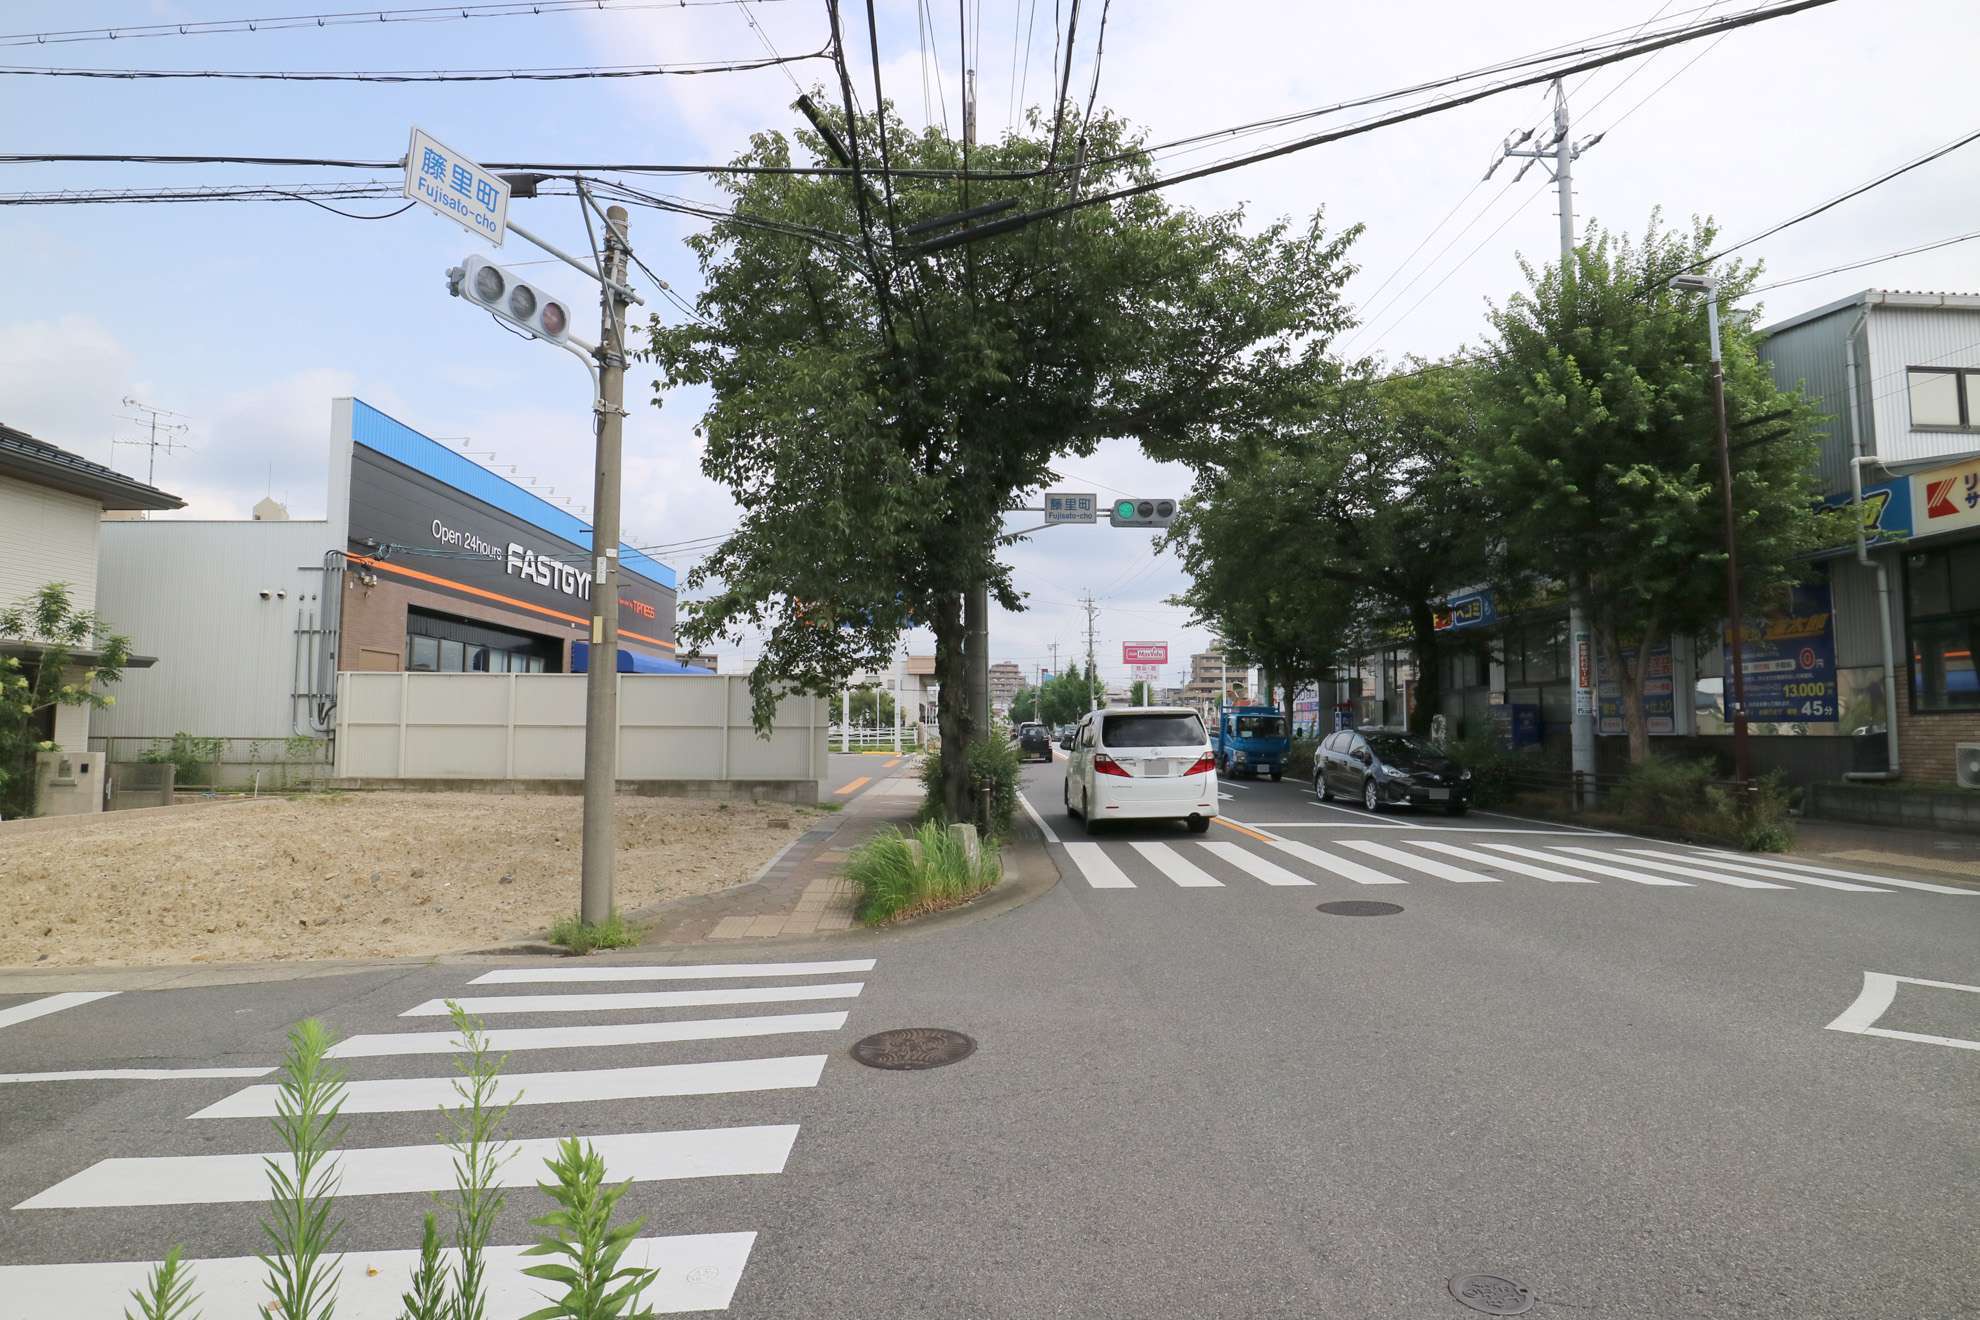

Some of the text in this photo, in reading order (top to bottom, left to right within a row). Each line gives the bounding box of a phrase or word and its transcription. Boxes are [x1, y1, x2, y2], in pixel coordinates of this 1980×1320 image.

[421, 146, 500, 213] 藤里町
[418, 176, 497, 233] Fujisato-cho
[1048, 511, 1093, 521] Fujisato-cho
[1050, 498, 1092, 511] 藤里町
[432, 519, 502, 560] Open 24hours
